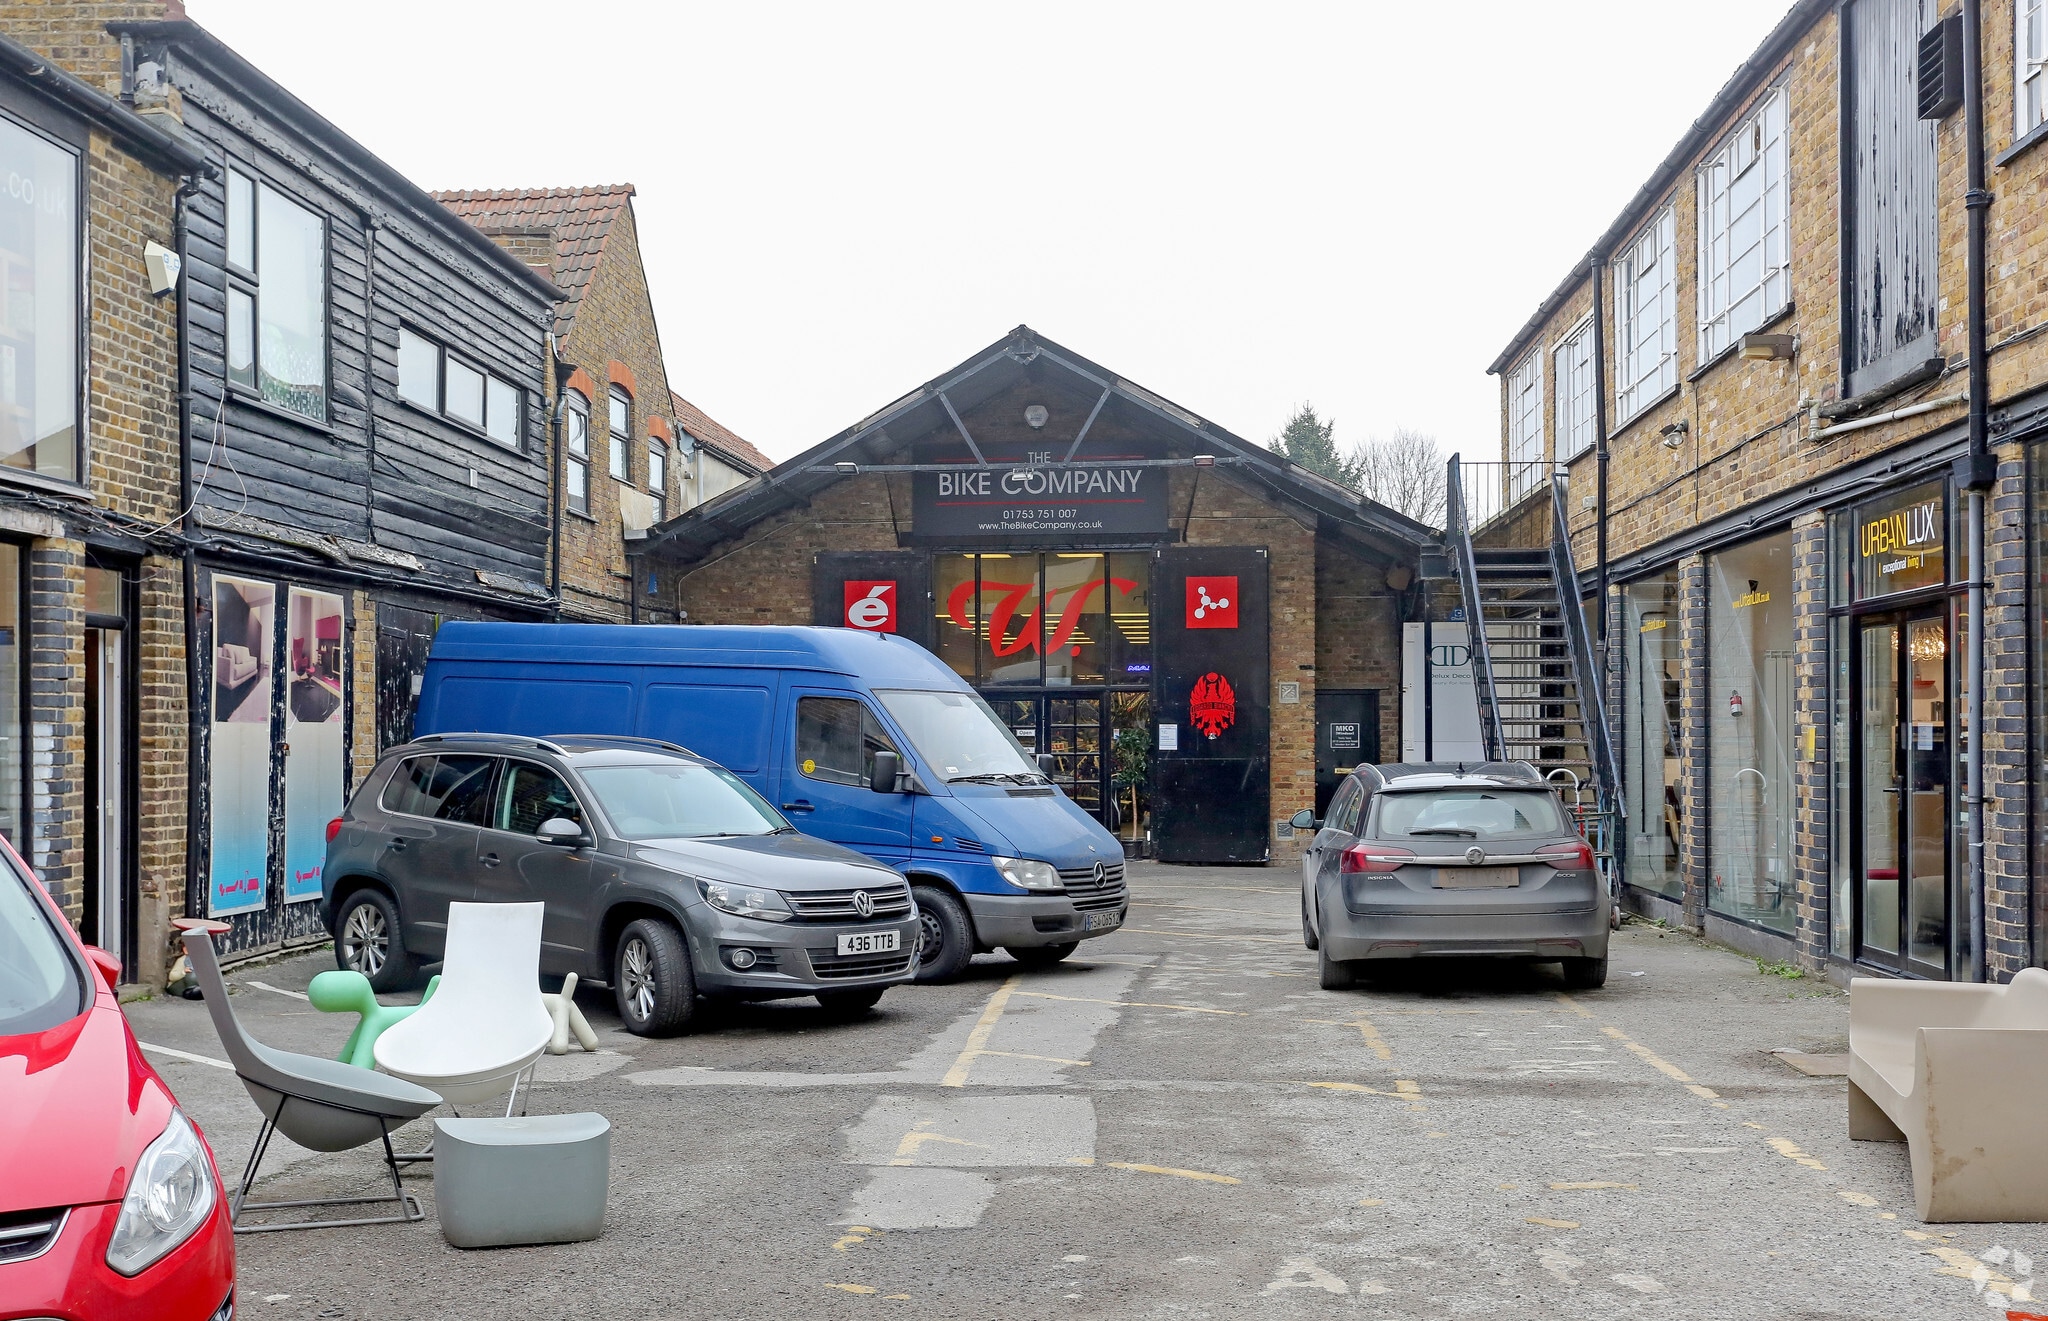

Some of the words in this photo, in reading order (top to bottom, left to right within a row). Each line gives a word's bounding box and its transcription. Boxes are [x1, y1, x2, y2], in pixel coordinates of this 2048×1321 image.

[1028, 452, 1051, 464] THE
[939, 472, 991, 496] BIKE
[1001, 469, 1142, 495] COMPANY
[1003, 510, 1034, 519] 01753
[1038, 509, 1054, 519] 751
[1058, 509, 1077, 518] 007
[978, 520, 1103, 530] www.TheBikeCompany.co.uk
[1861, 502, 1935, 558] URBANLUX
[1882, 556, 1907, 574] exceptional
[1907, 555, 1919, 569] living
[847, 936, 870, 952] 436
[873, 934, 893, 950] TTB
